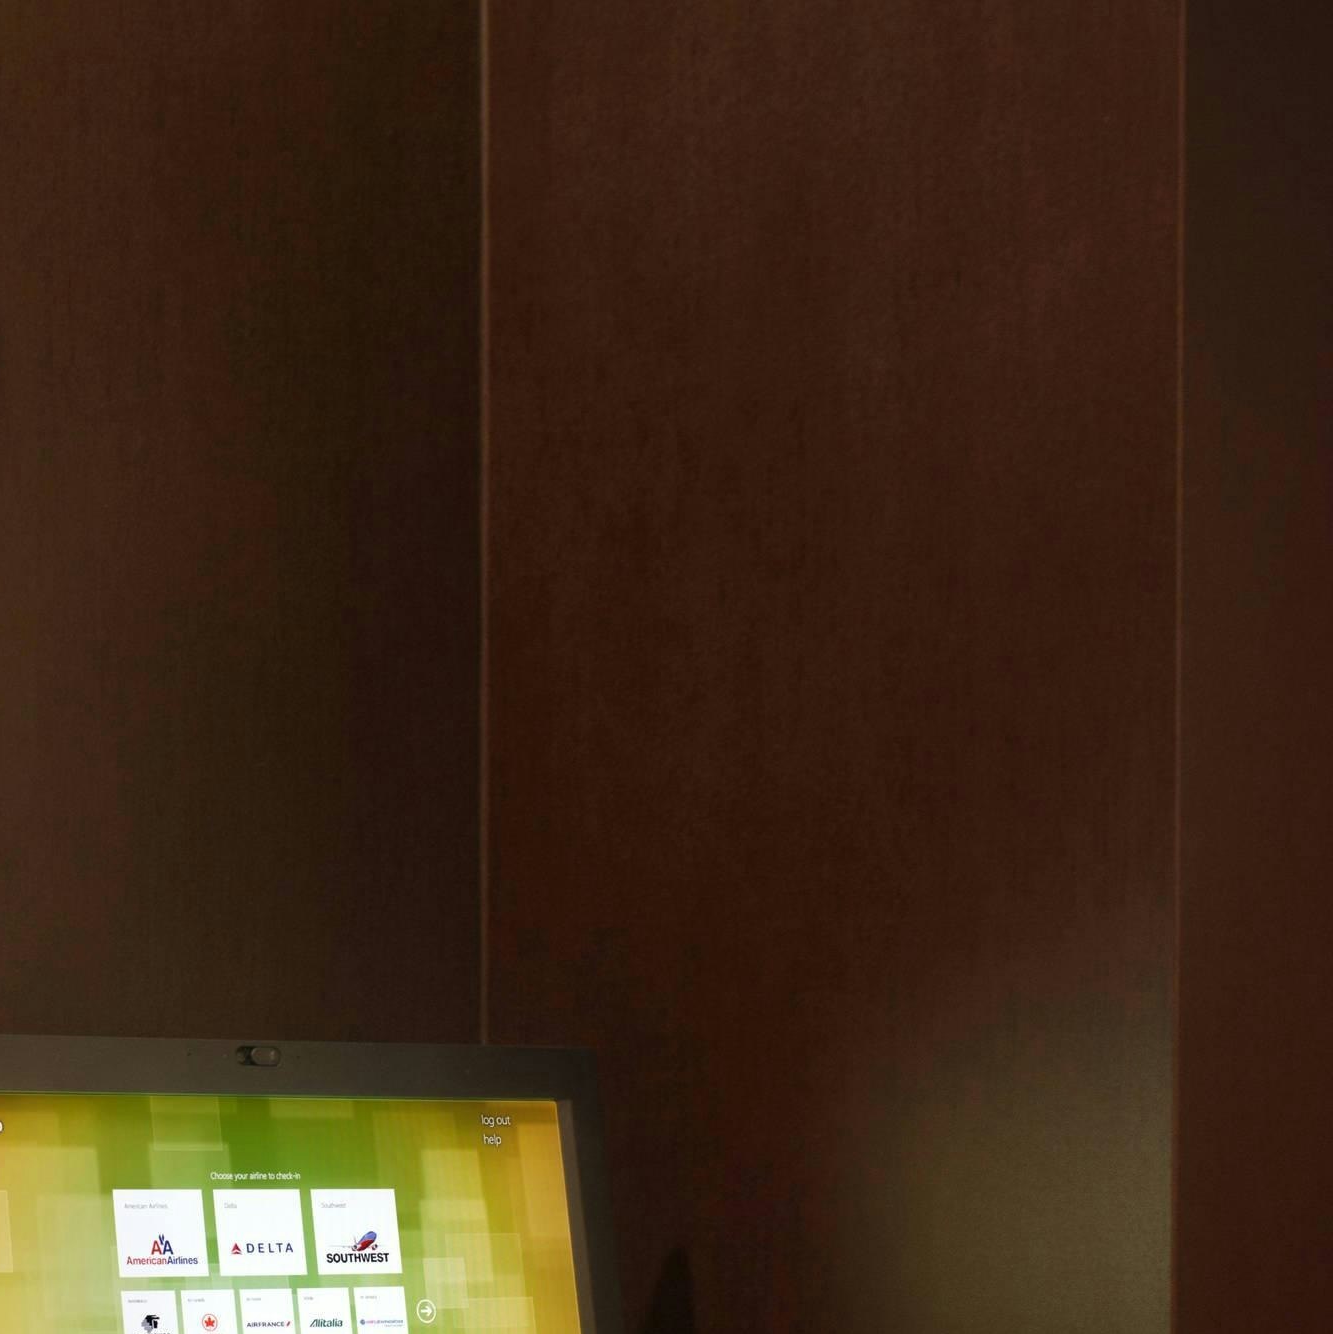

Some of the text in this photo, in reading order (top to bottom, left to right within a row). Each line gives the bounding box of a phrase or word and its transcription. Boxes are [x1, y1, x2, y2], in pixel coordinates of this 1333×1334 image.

[481, 1114, 511, 1127] log out
[483, 1133, 502, 1147] help
[210, 1171, 301, 1181] Choose your airline to check-in
[246, 1242, 294, 1253] DELTA
[326, 1252, 389, 1263] SOUTHWEST
[310, 1318, 343, 1327] Alitalia
